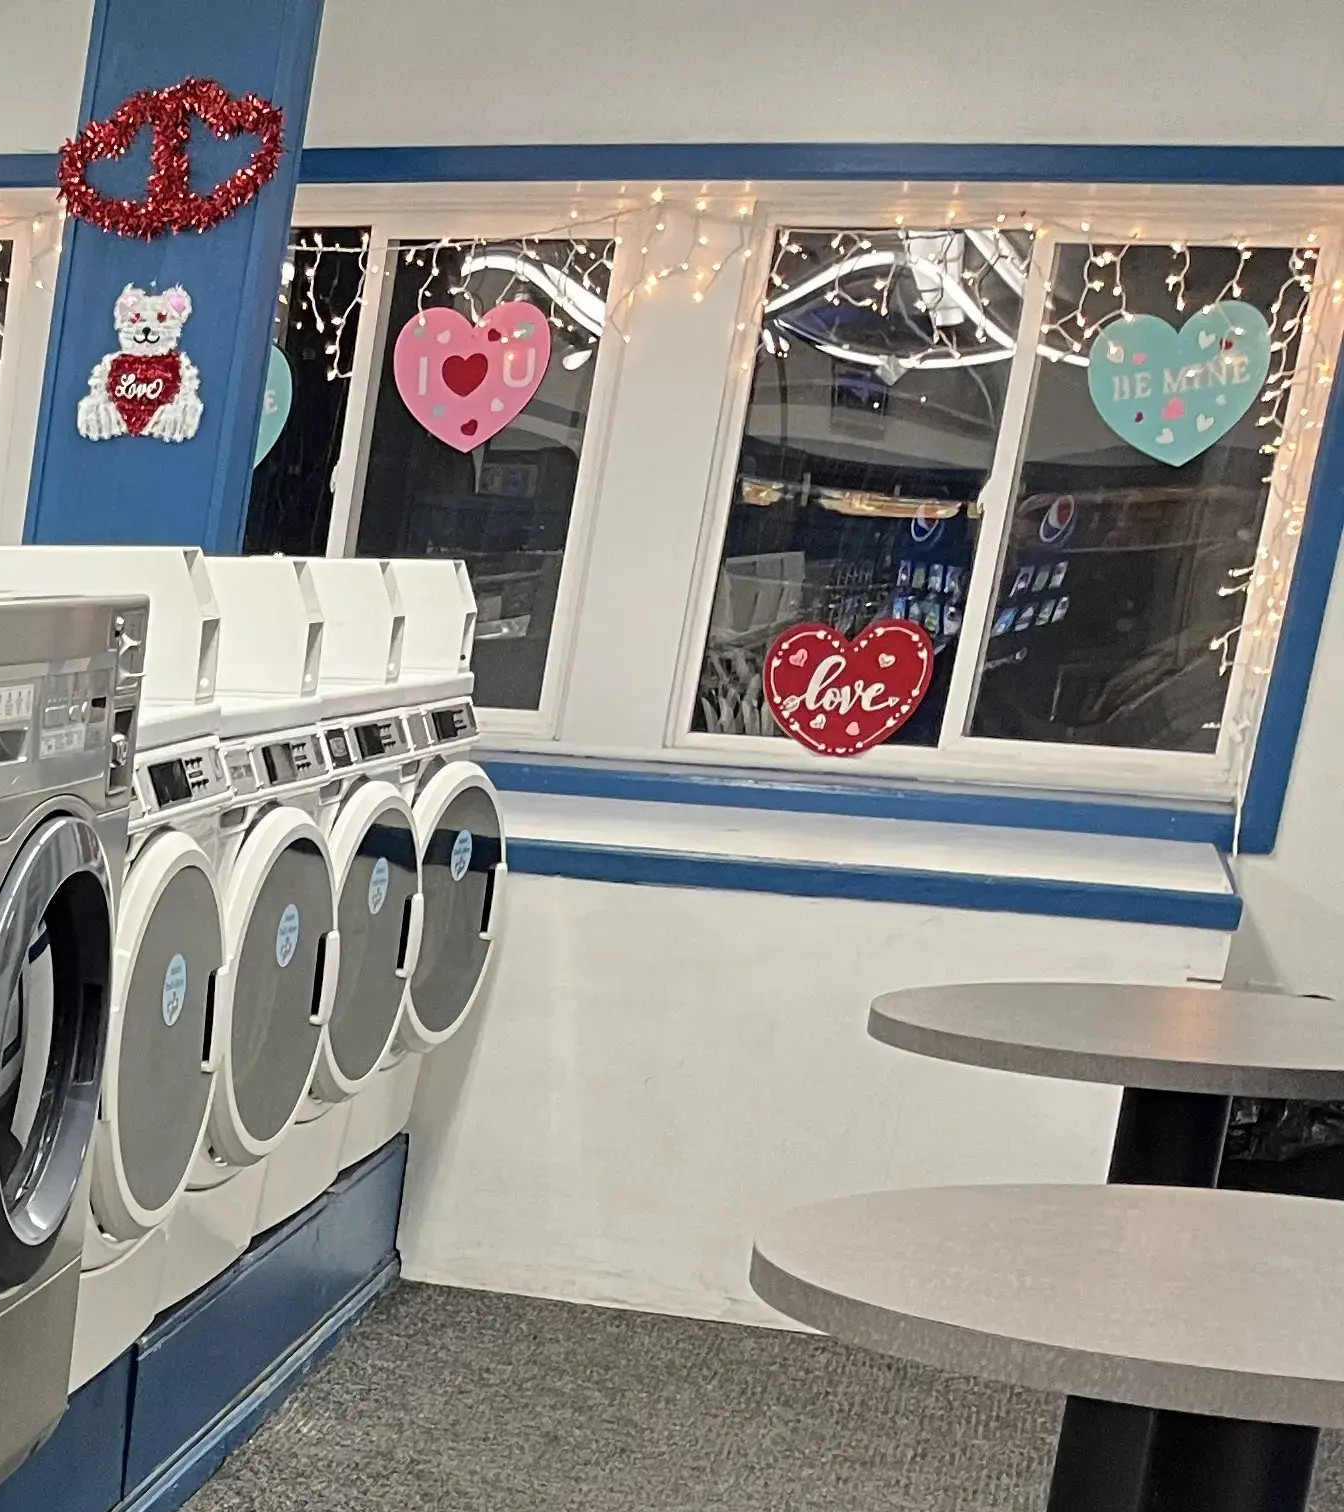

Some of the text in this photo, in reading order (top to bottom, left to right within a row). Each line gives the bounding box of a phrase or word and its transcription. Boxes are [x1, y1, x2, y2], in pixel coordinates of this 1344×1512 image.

[115, 373, 164, 400] Love
[418, 348, 535, 396] I U
[1112, 354, 1251, 402] BE MINE
[802, 655, 894, 715] love
